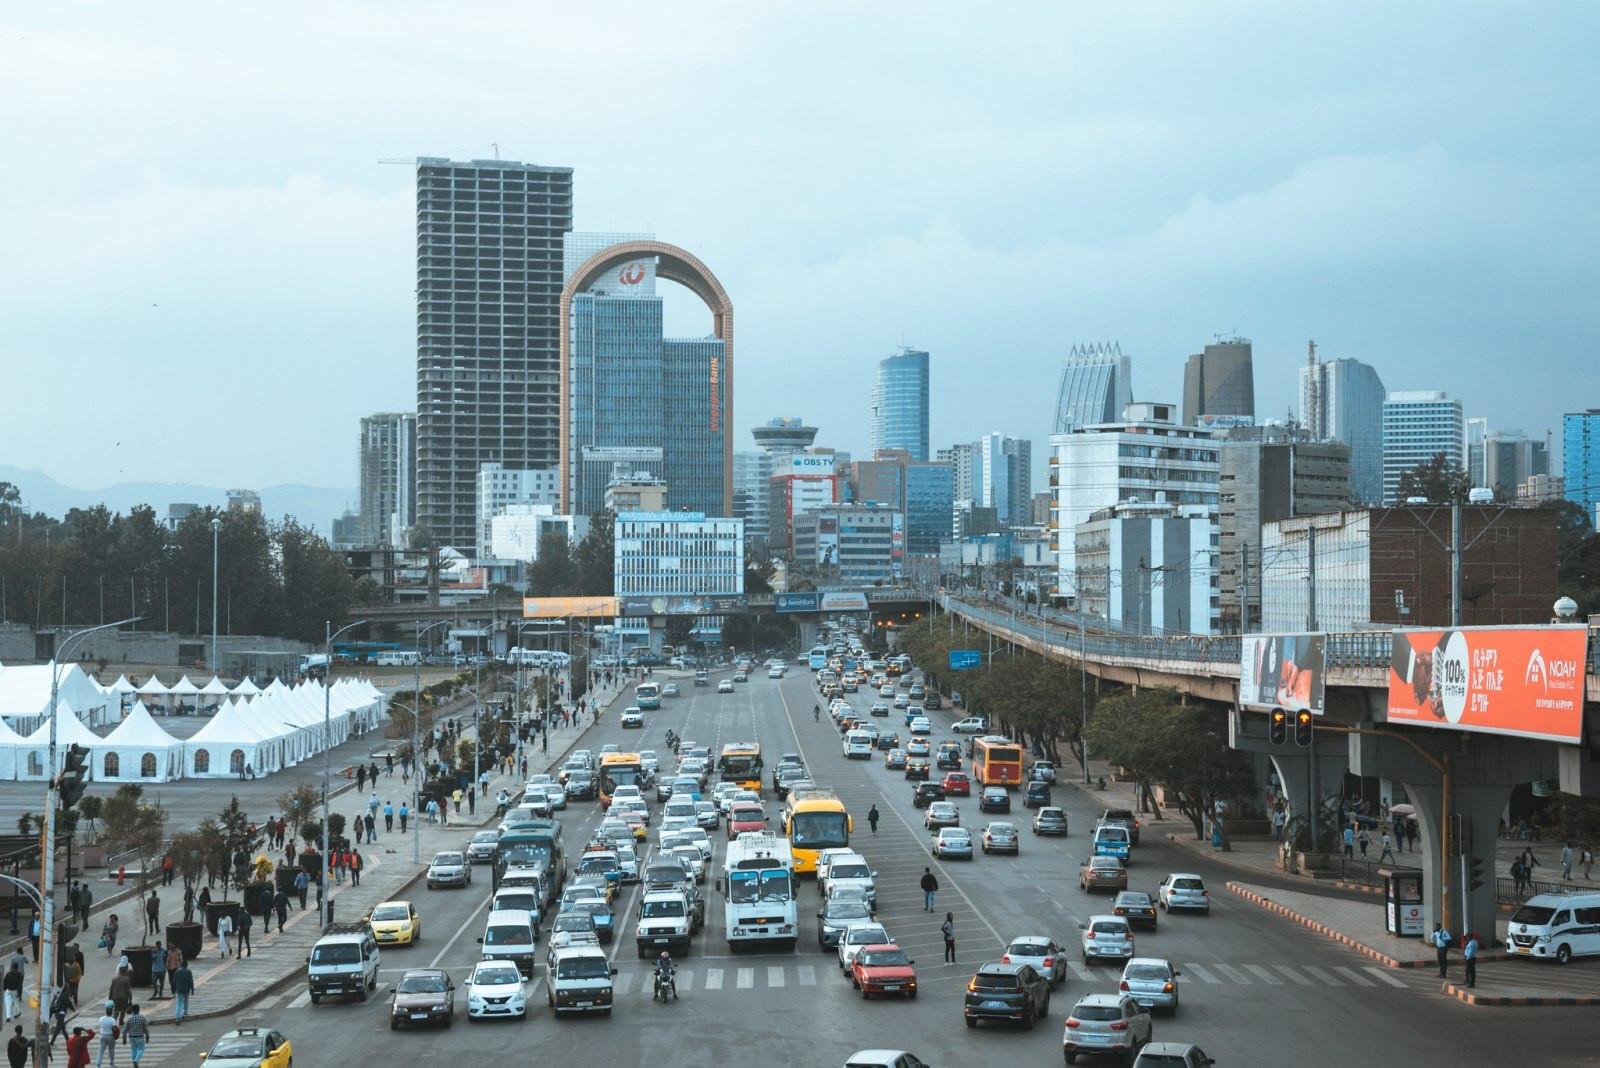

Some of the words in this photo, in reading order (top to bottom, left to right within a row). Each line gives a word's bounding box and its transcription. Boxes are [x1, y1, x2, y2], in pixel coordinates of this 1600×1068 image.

[803, 458, 821, 466] OBS
[823, 458, 835, 466] TV
[1444, 659, 1465, 684] 100%
[1549, 660, 1576, 678] NOAH
